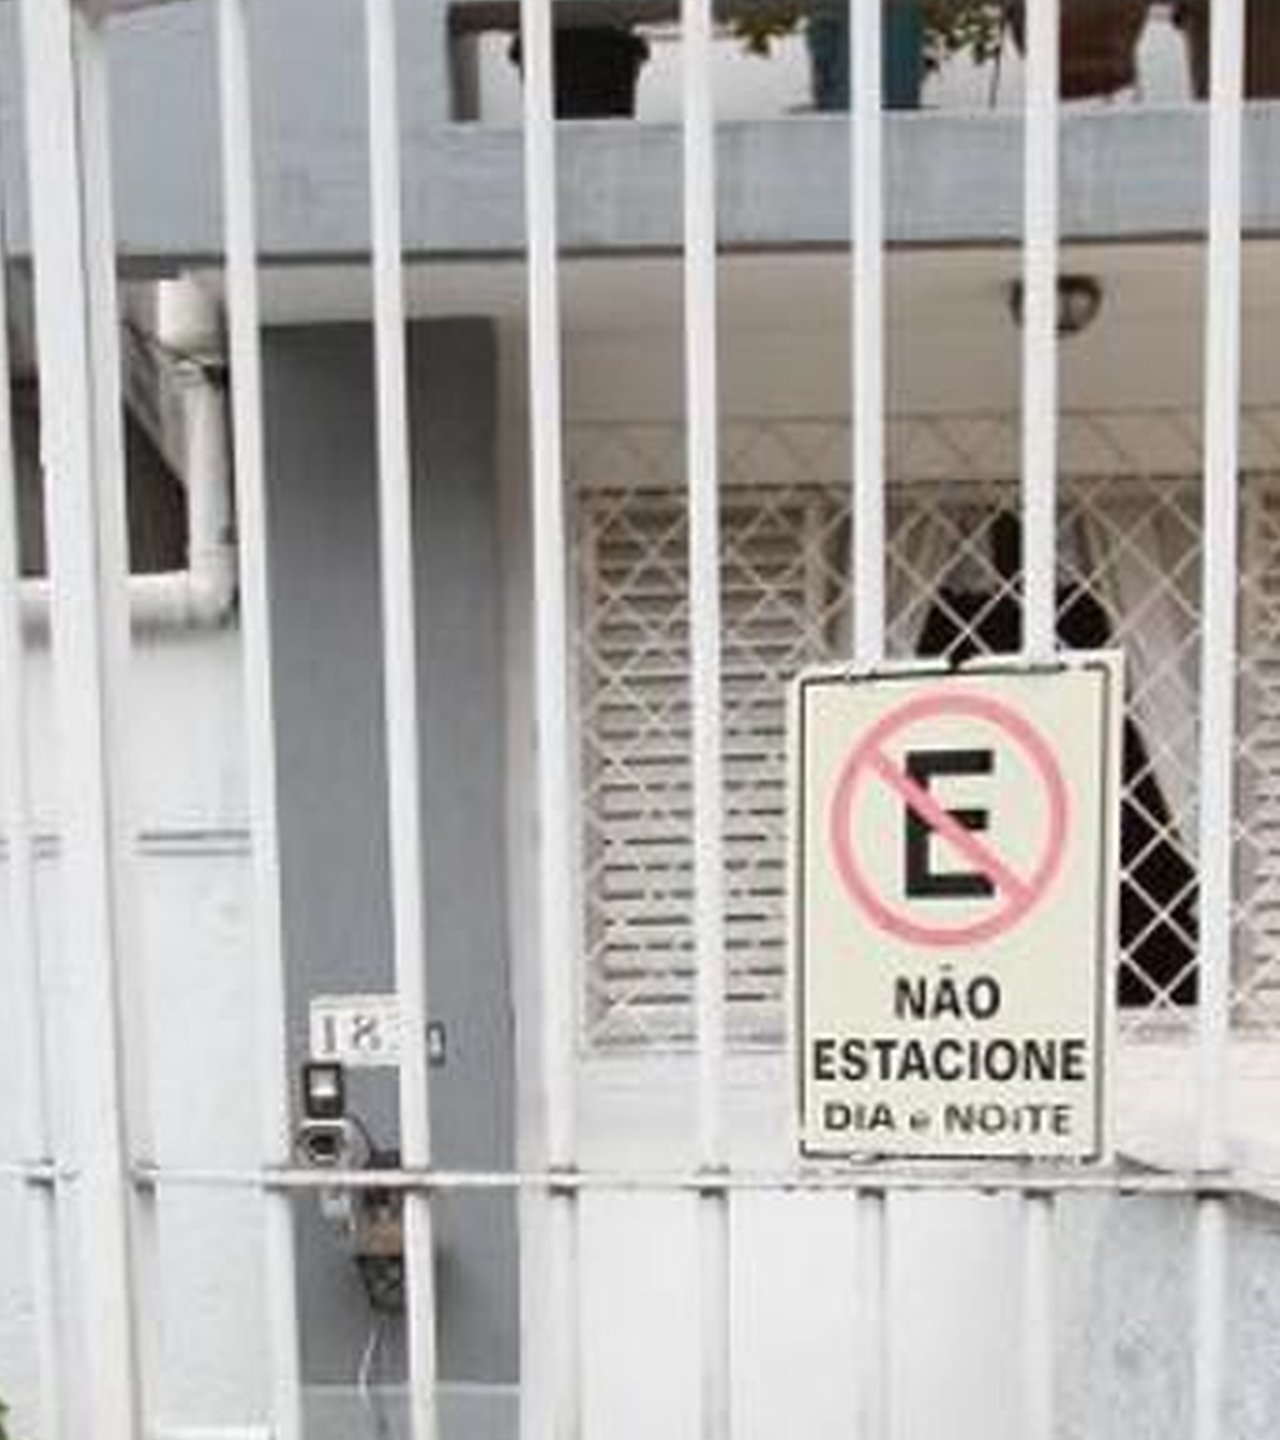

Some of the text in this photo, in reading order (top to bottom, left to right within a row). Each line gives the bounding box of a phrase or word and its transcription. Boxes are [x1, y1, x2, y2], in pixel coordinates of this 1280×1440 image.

[904, 748, 995, 898] E
[894, 962, 1002, 1021] NÃO
[811, 1038, 1088, 1083] ESTACIONE
[823, 1101, 897, 1133] DIA
[944, 1103, 1074, 1137] NOITE
